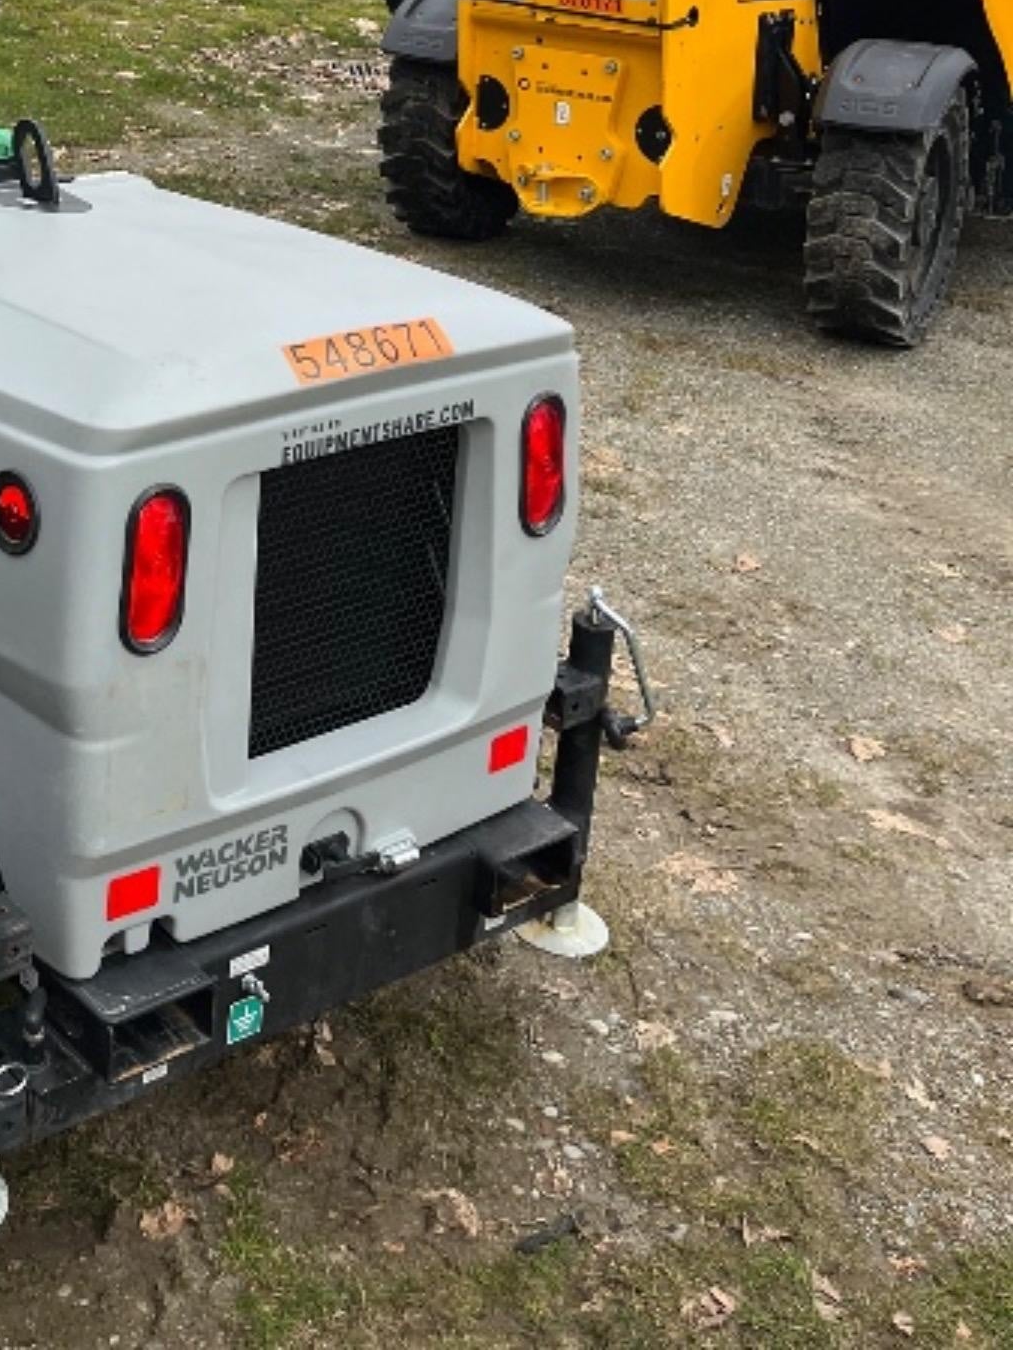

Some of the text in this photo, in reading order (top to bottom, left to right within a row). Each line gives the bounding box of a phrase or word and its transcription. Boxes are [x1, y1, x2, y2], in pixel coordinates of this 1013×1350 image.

[290, 321, 444, 379] 548671
[173, 845, 288, 904] NEUSON
[175, 825, 288, 877] WACKER
